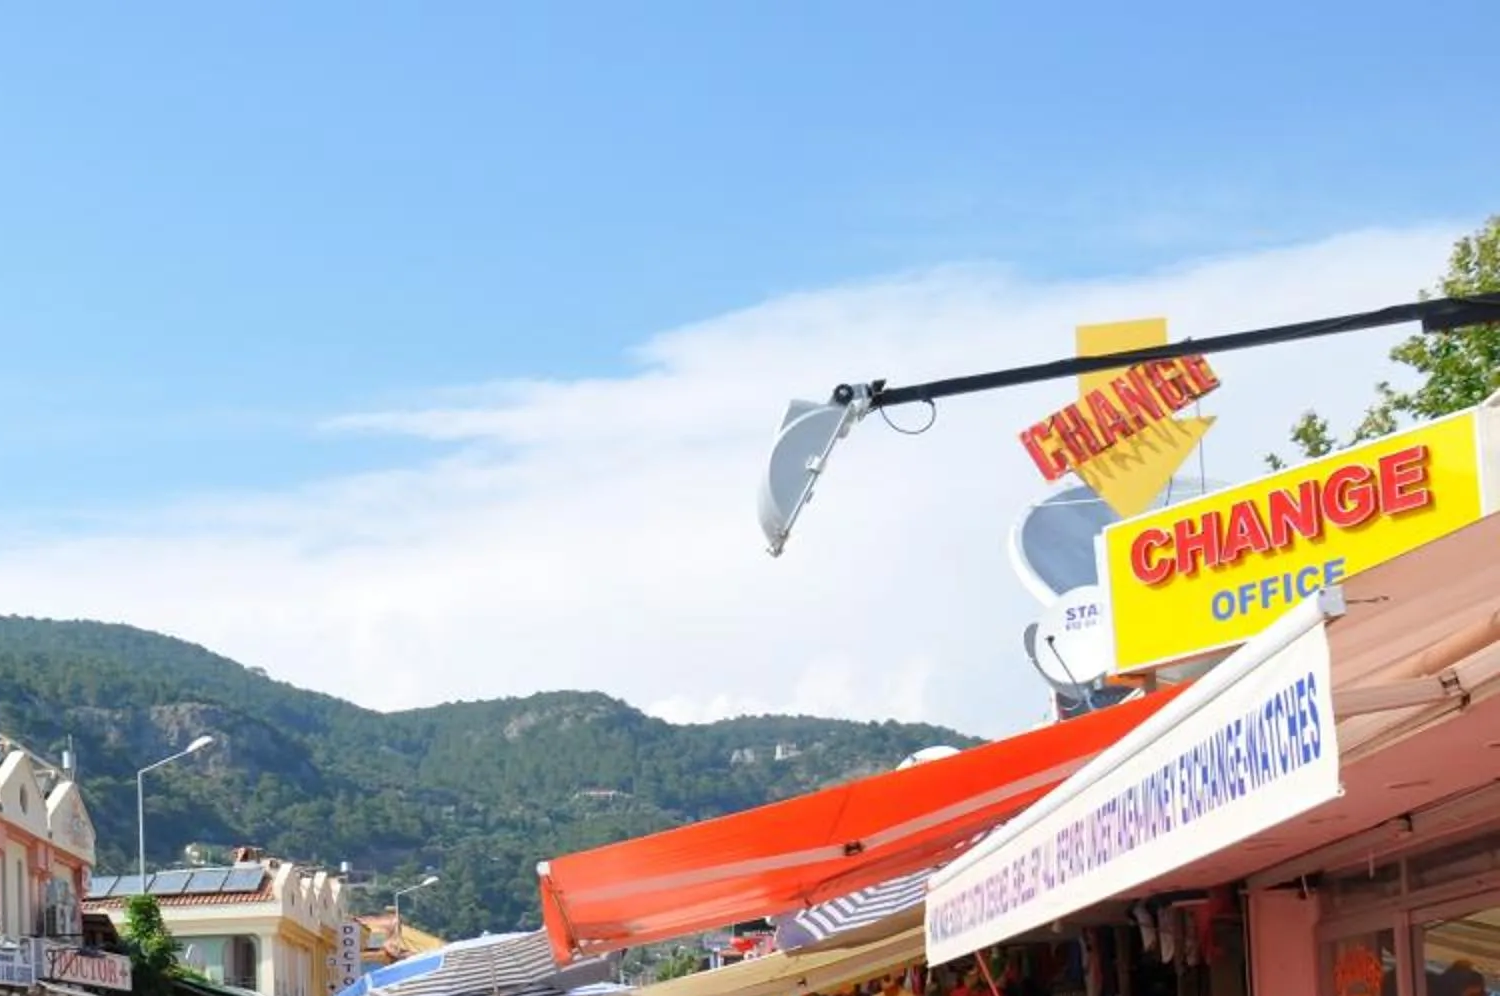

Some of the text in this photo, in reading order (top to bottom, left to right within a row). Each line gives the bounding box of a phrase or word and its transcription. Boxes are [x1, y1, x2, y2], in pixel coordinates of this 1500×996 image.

[1019, 352, 1221, 482] CHANGE
[1130, 444, 1433, 586] CHANGE
[1211, 556, 1347, 622] OFFICE
[342, 924, 356, 987] DOCTO
